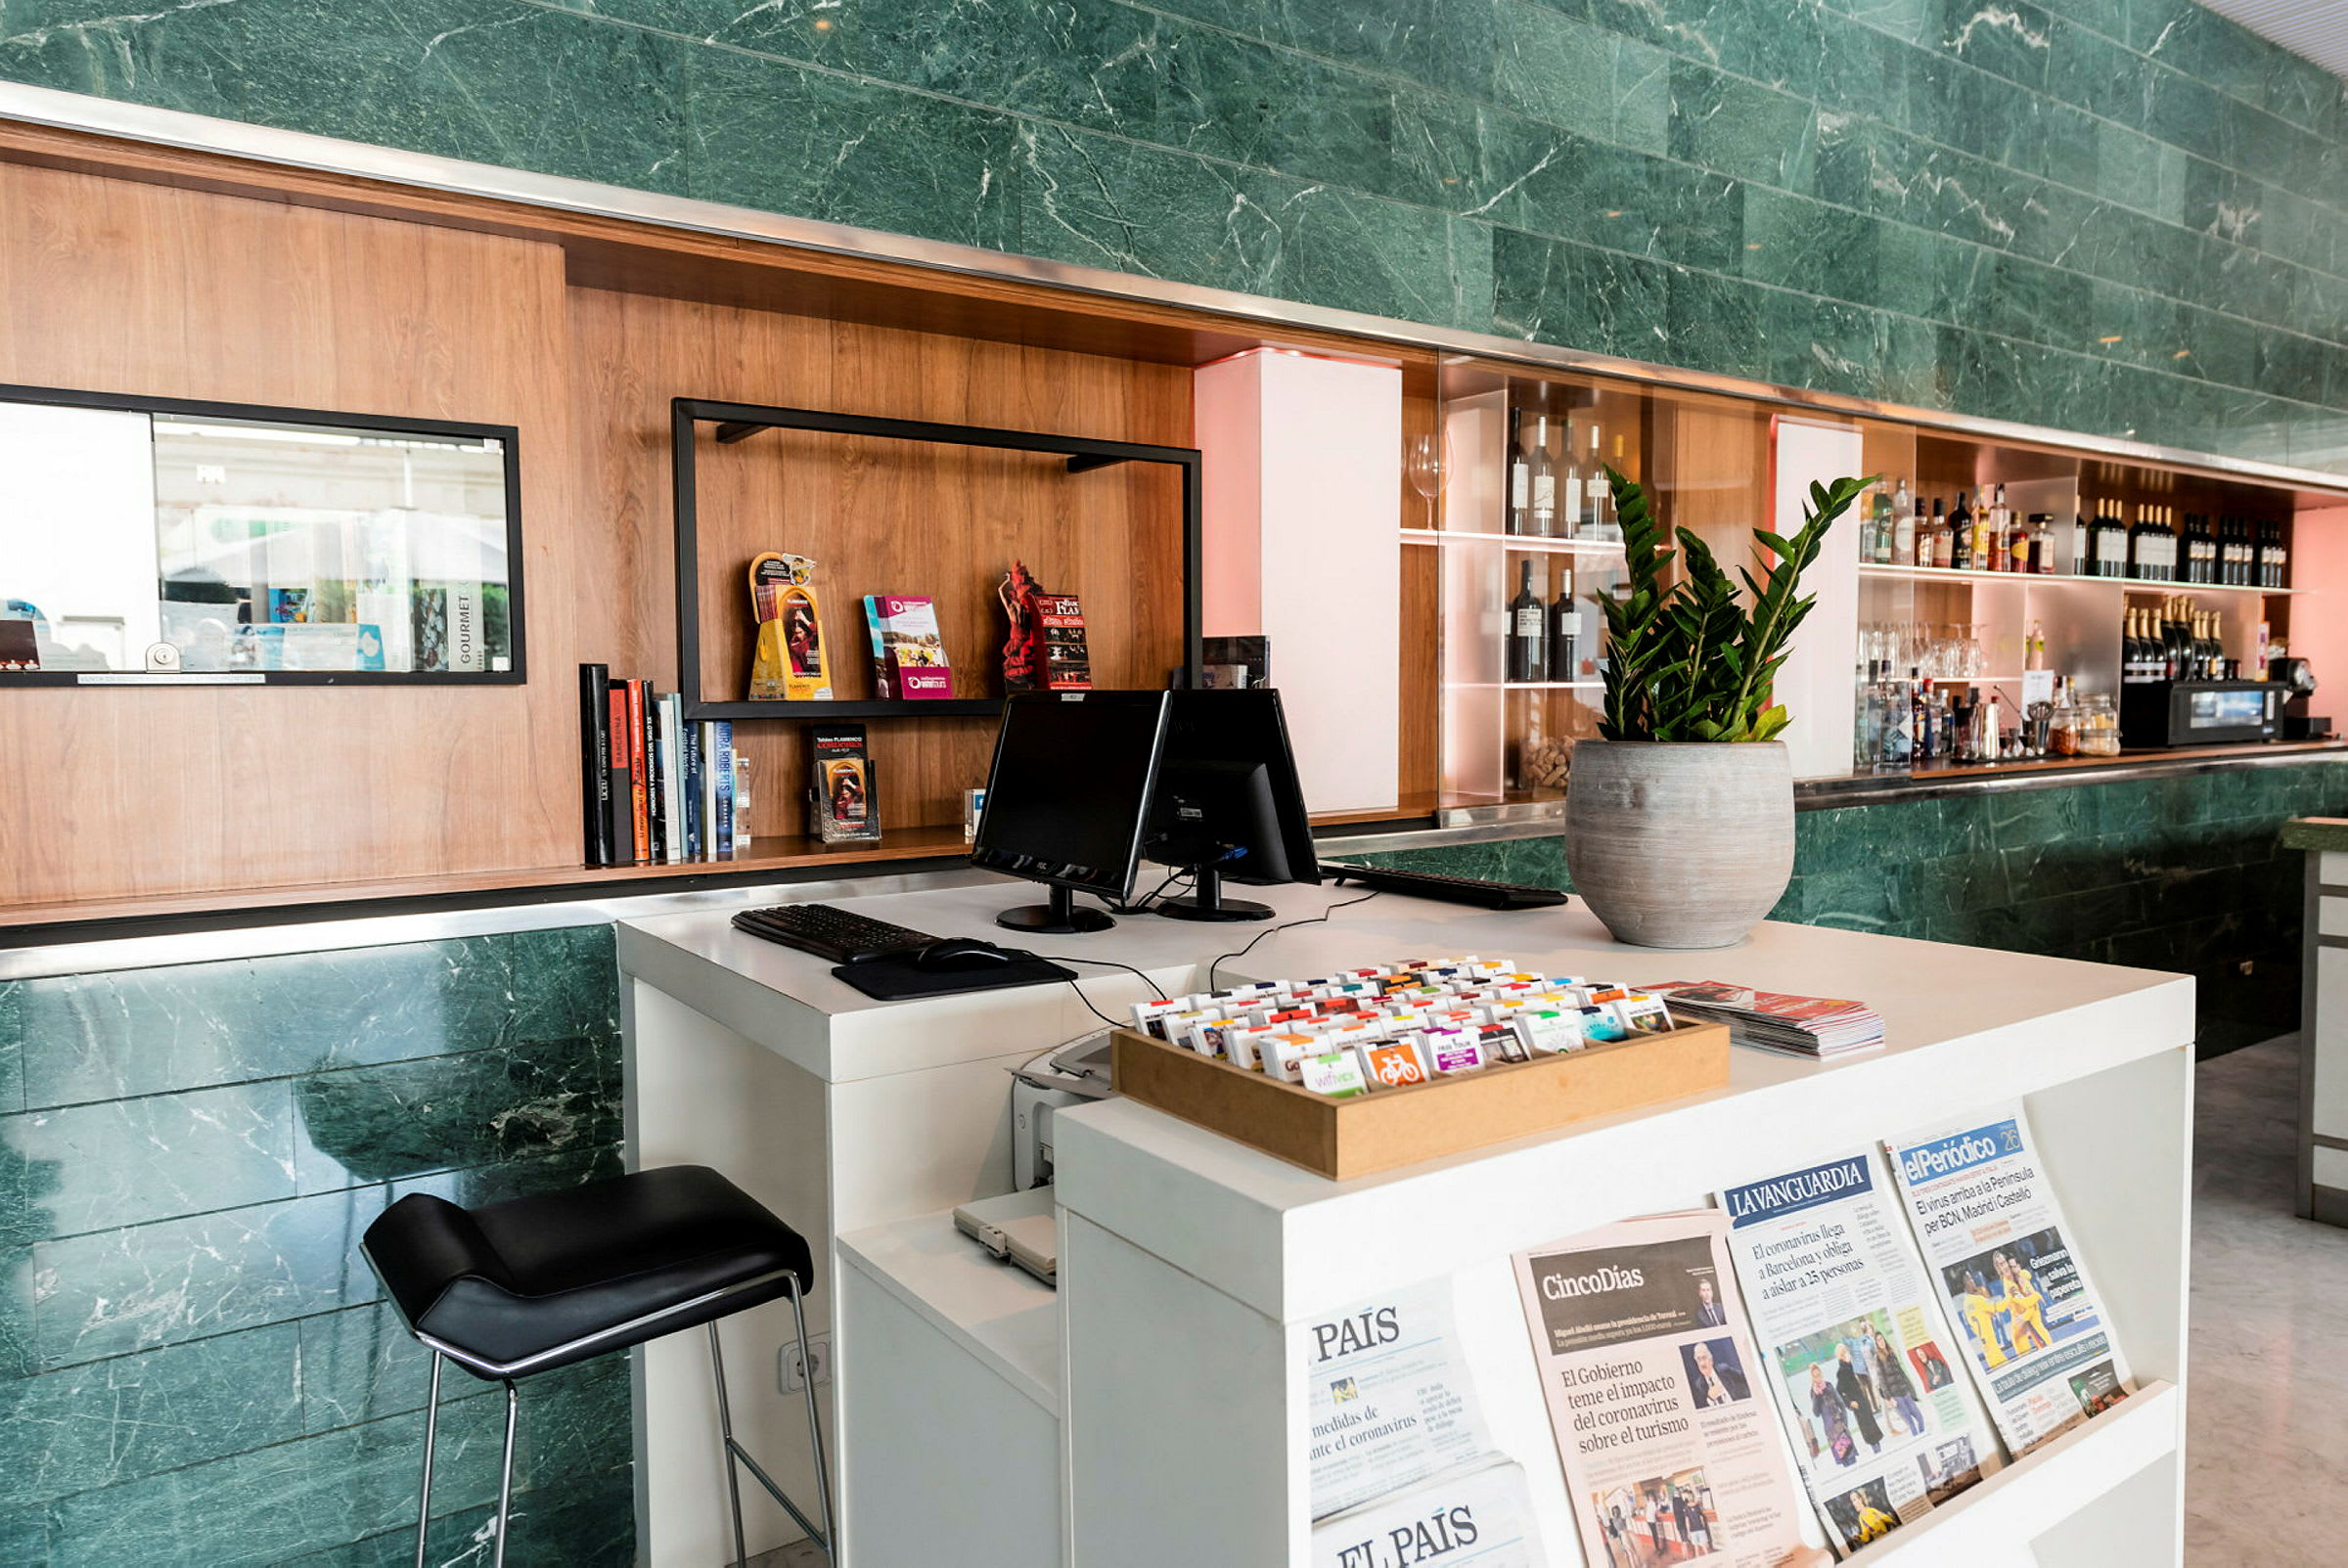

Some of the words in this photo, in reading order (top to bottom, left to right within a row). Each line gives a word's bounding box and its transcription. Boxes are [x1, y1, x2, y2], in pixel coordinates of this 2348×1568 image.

[458, 594, 471, 664] GOURMET
[718, 724, 730, 749] NORA
[719, 751, 731, 791] ROBERTS
[1733, 1192, 1755, 1217] LA
[1752, 1162, 1865, 1210] VANGUARDIA
[1916, 1200, 1927, 1216] El
[1928, 1194, 1950, 1211] virus
[1951, 1187, 1975, 1206] arriba
[1983, 1180, 1990, 1192] la
[1924, 1222, 1939, 1236] per
[1938, 1210, 1964, 1230] BCN,
[1961, 1200, 1994, 1221] Madrid
[1752, 1245, 1766, 1260] El
[1766, 1232, 1821, 1256] coronavirus
[1820, 1223, 1845, 1240] llega
[1759, 1269, 1766, 1279] a
[1765, 1250, 1816, 1276] Barcelona
[1824, 1240, 1854, 1260] obliga
[1543, 1265, 1645, 1301] CincoDías
[1763, 1289, 1770, 1300] a
[1770, 1277, 1798, 1297] aislar
[1799, 1277, 1806, 1288] a
[1805, 1271, 1820, 1284] 25
[1821, 1257, 1865, 1283] personas
[1312, 1306, 1400, 1362] PAÍS
[1561, 1369, 1577, 1387] El
[1577, 1361, 1644, 1384] Gobierno
[1567, 1390, 1604, 1410] teme
[1606, 1384, 1620, 1402] el
[1620, 1375, 1675, 1399] impacto
[1312, 1410, 1362, 1439] medidas
[1365, 1405, 1379, 1420] de
[1573, 1411, 1597, 1432] del
[1598, 1397, 1680, 1427] coronavirus
[1335, 1437, 1346, 1452] el
[1349, 1414, 1419, 1448] coronavirus
[1579, 1433, 1618, 1454] sobre
[1620, 1426, 1634, 1445] el
[1635, 1418, 1690, 1441] turismo
[1388, 1504, 1478, 1568] PAÍS
